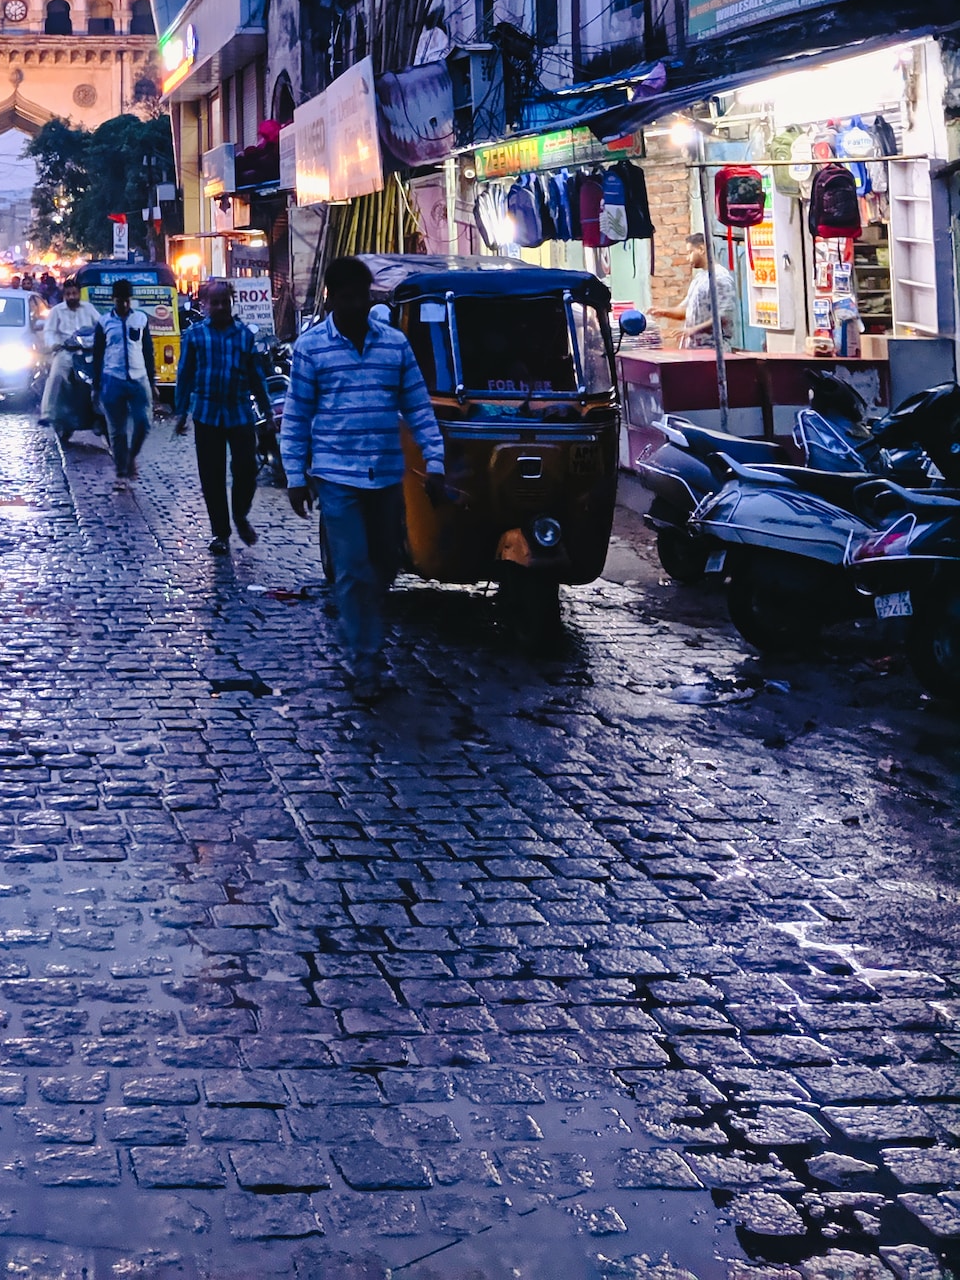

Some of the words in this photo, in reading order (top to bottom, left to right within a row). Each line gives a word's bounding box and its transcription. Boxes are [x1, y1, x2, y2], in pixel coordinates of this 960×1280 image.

[483, 139, 538, 177] ZEENATH
[233, 290, 269, 302] EROX
[488, 379, 515, 391] FOR
